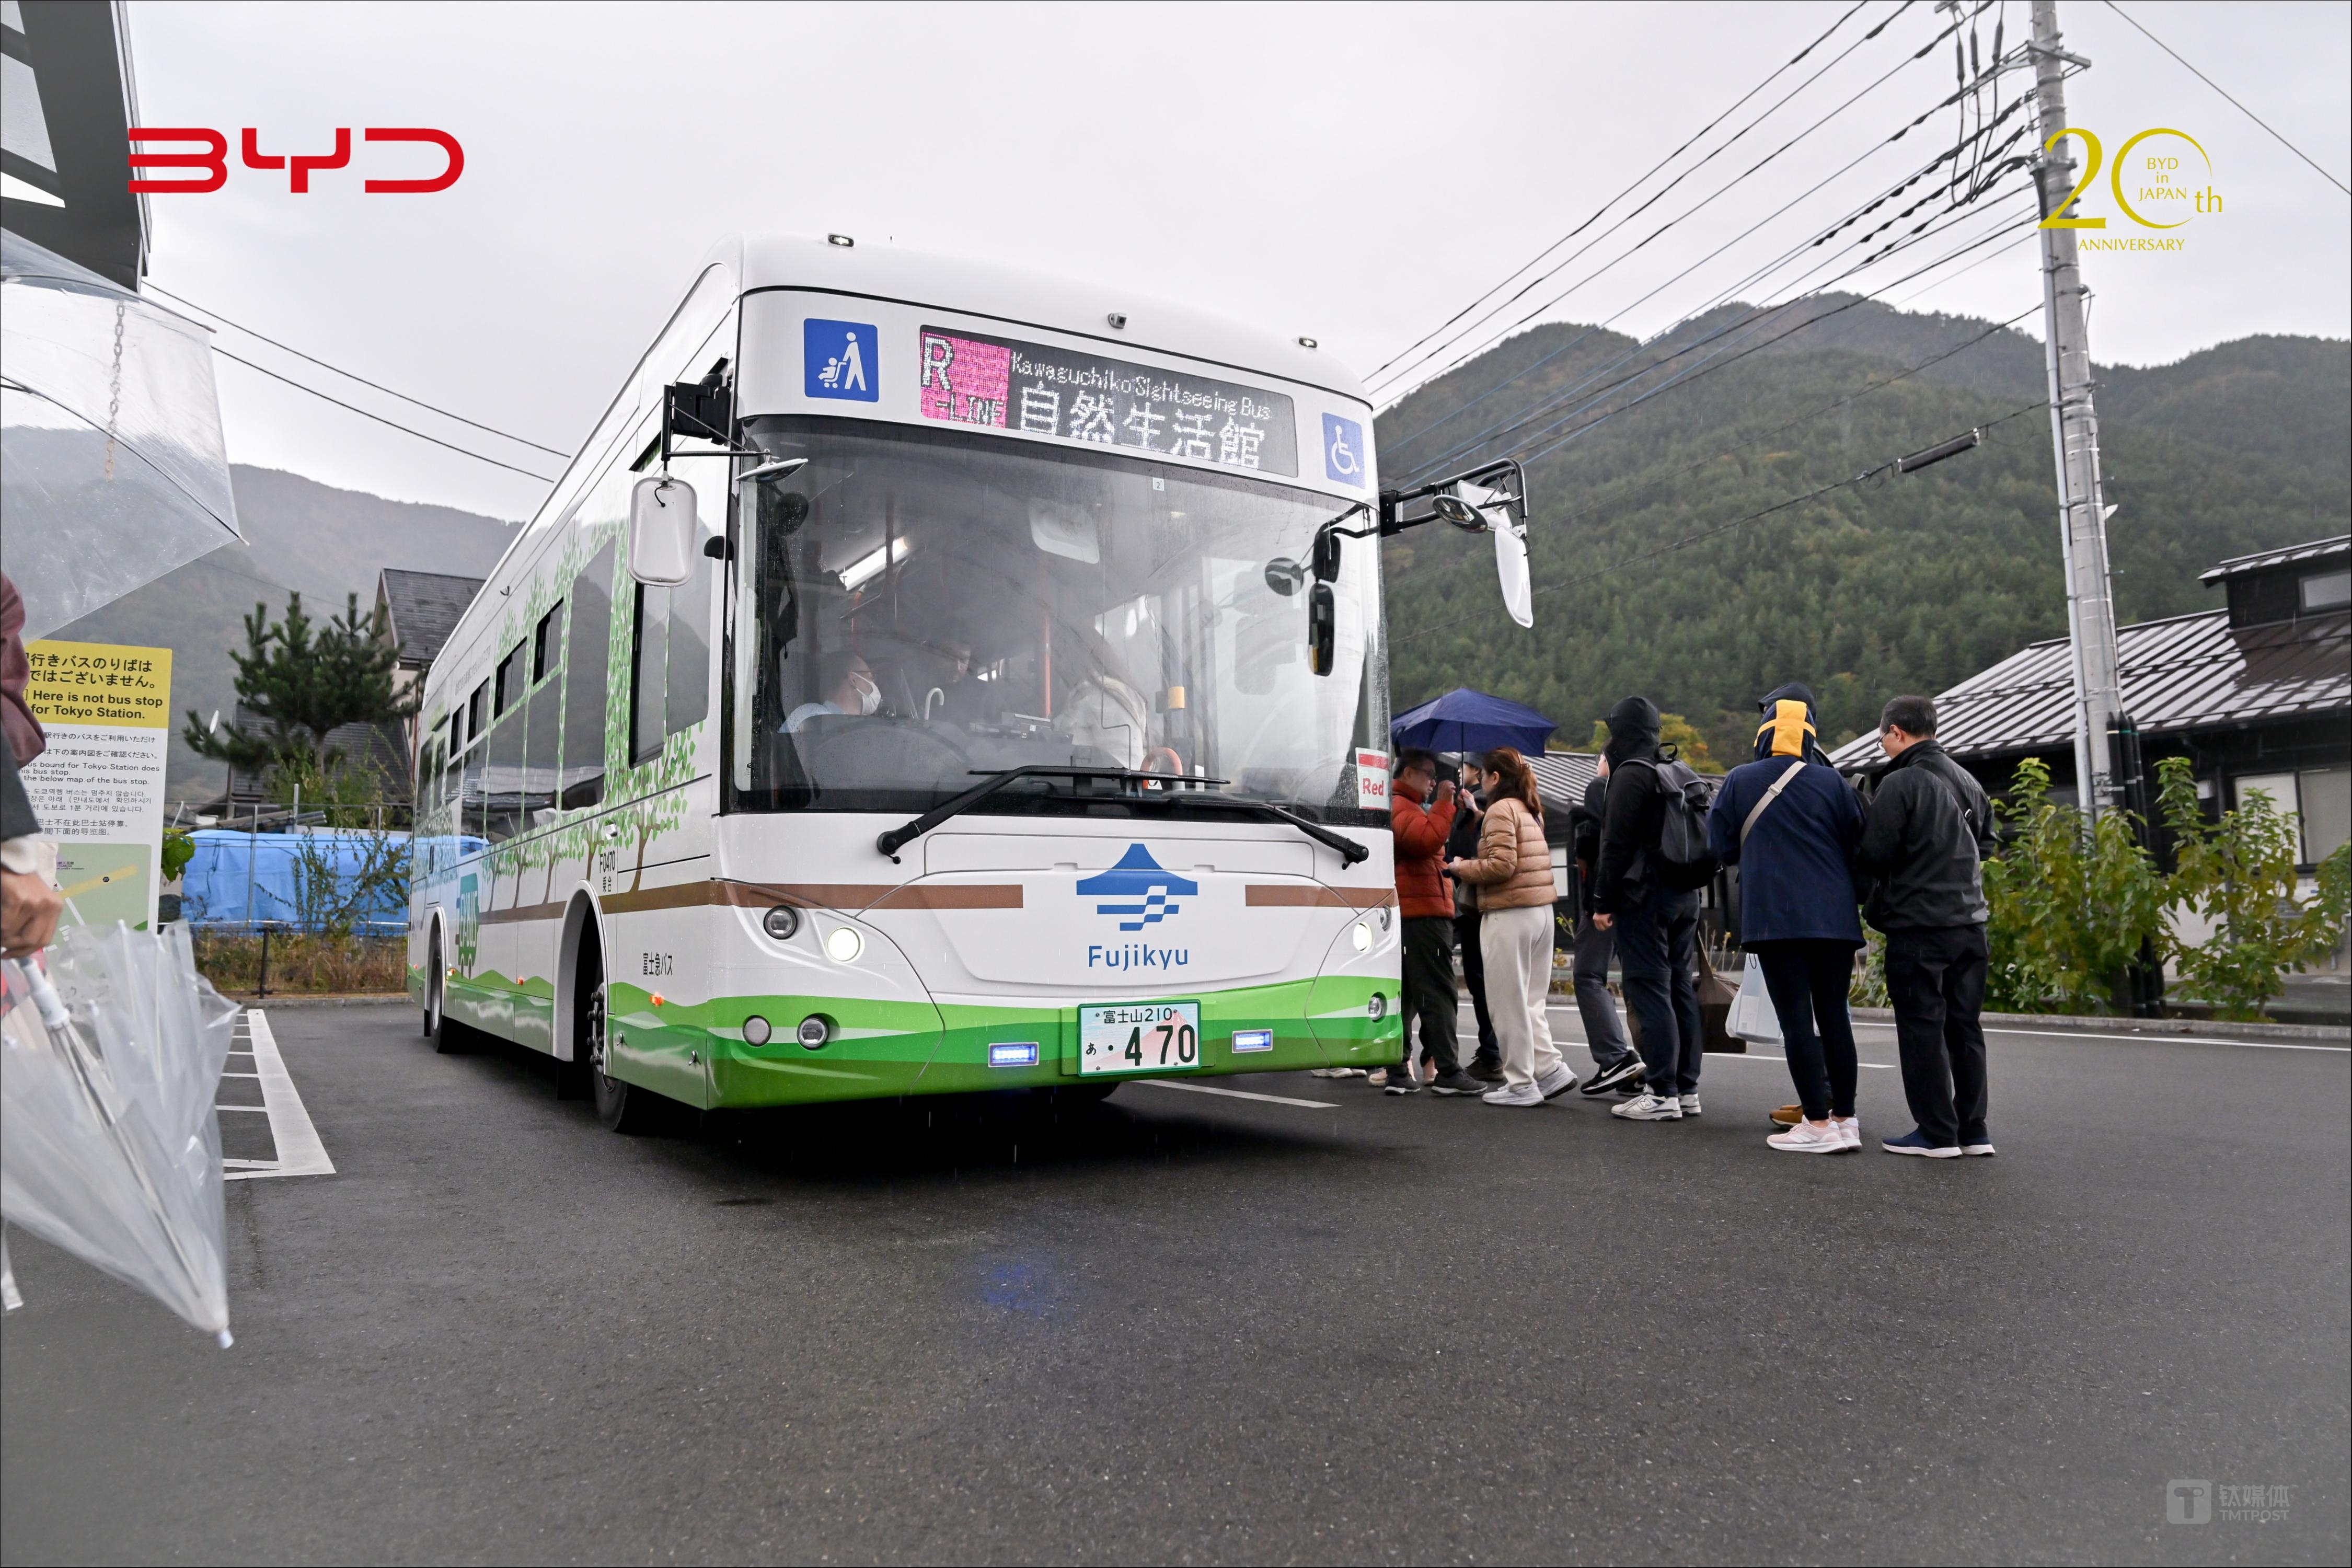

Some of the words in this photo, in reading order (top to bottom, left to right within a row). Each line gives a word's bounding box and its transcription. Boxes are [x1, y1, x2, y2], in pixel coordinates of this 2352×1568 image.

[922, 337, 953, 390] R
[1241, 396, 1271, 420] Bus
[1020, 381, 1265, 469] 自然生活館
[26, 653, 152, 672] 行きバスのりばは
[33, 690, 63, 701] Here
[68, 692, 78, 701] is
[83, 694, 104, 703] not
[108, 694, 131, 705] bus
[135, 697, 163, 708] stop
[30, 704, 50, 714] for
[54, 705, 93, 718] Tokyo
[97, 707, 145, 719] Station.
[1363, 778, 1384, 795] Red
[599, 850, 616, 873] F0470
[643, 952, 673, 976] 富士急バス
[1089, 944, 1188, 971] Fujikyu
